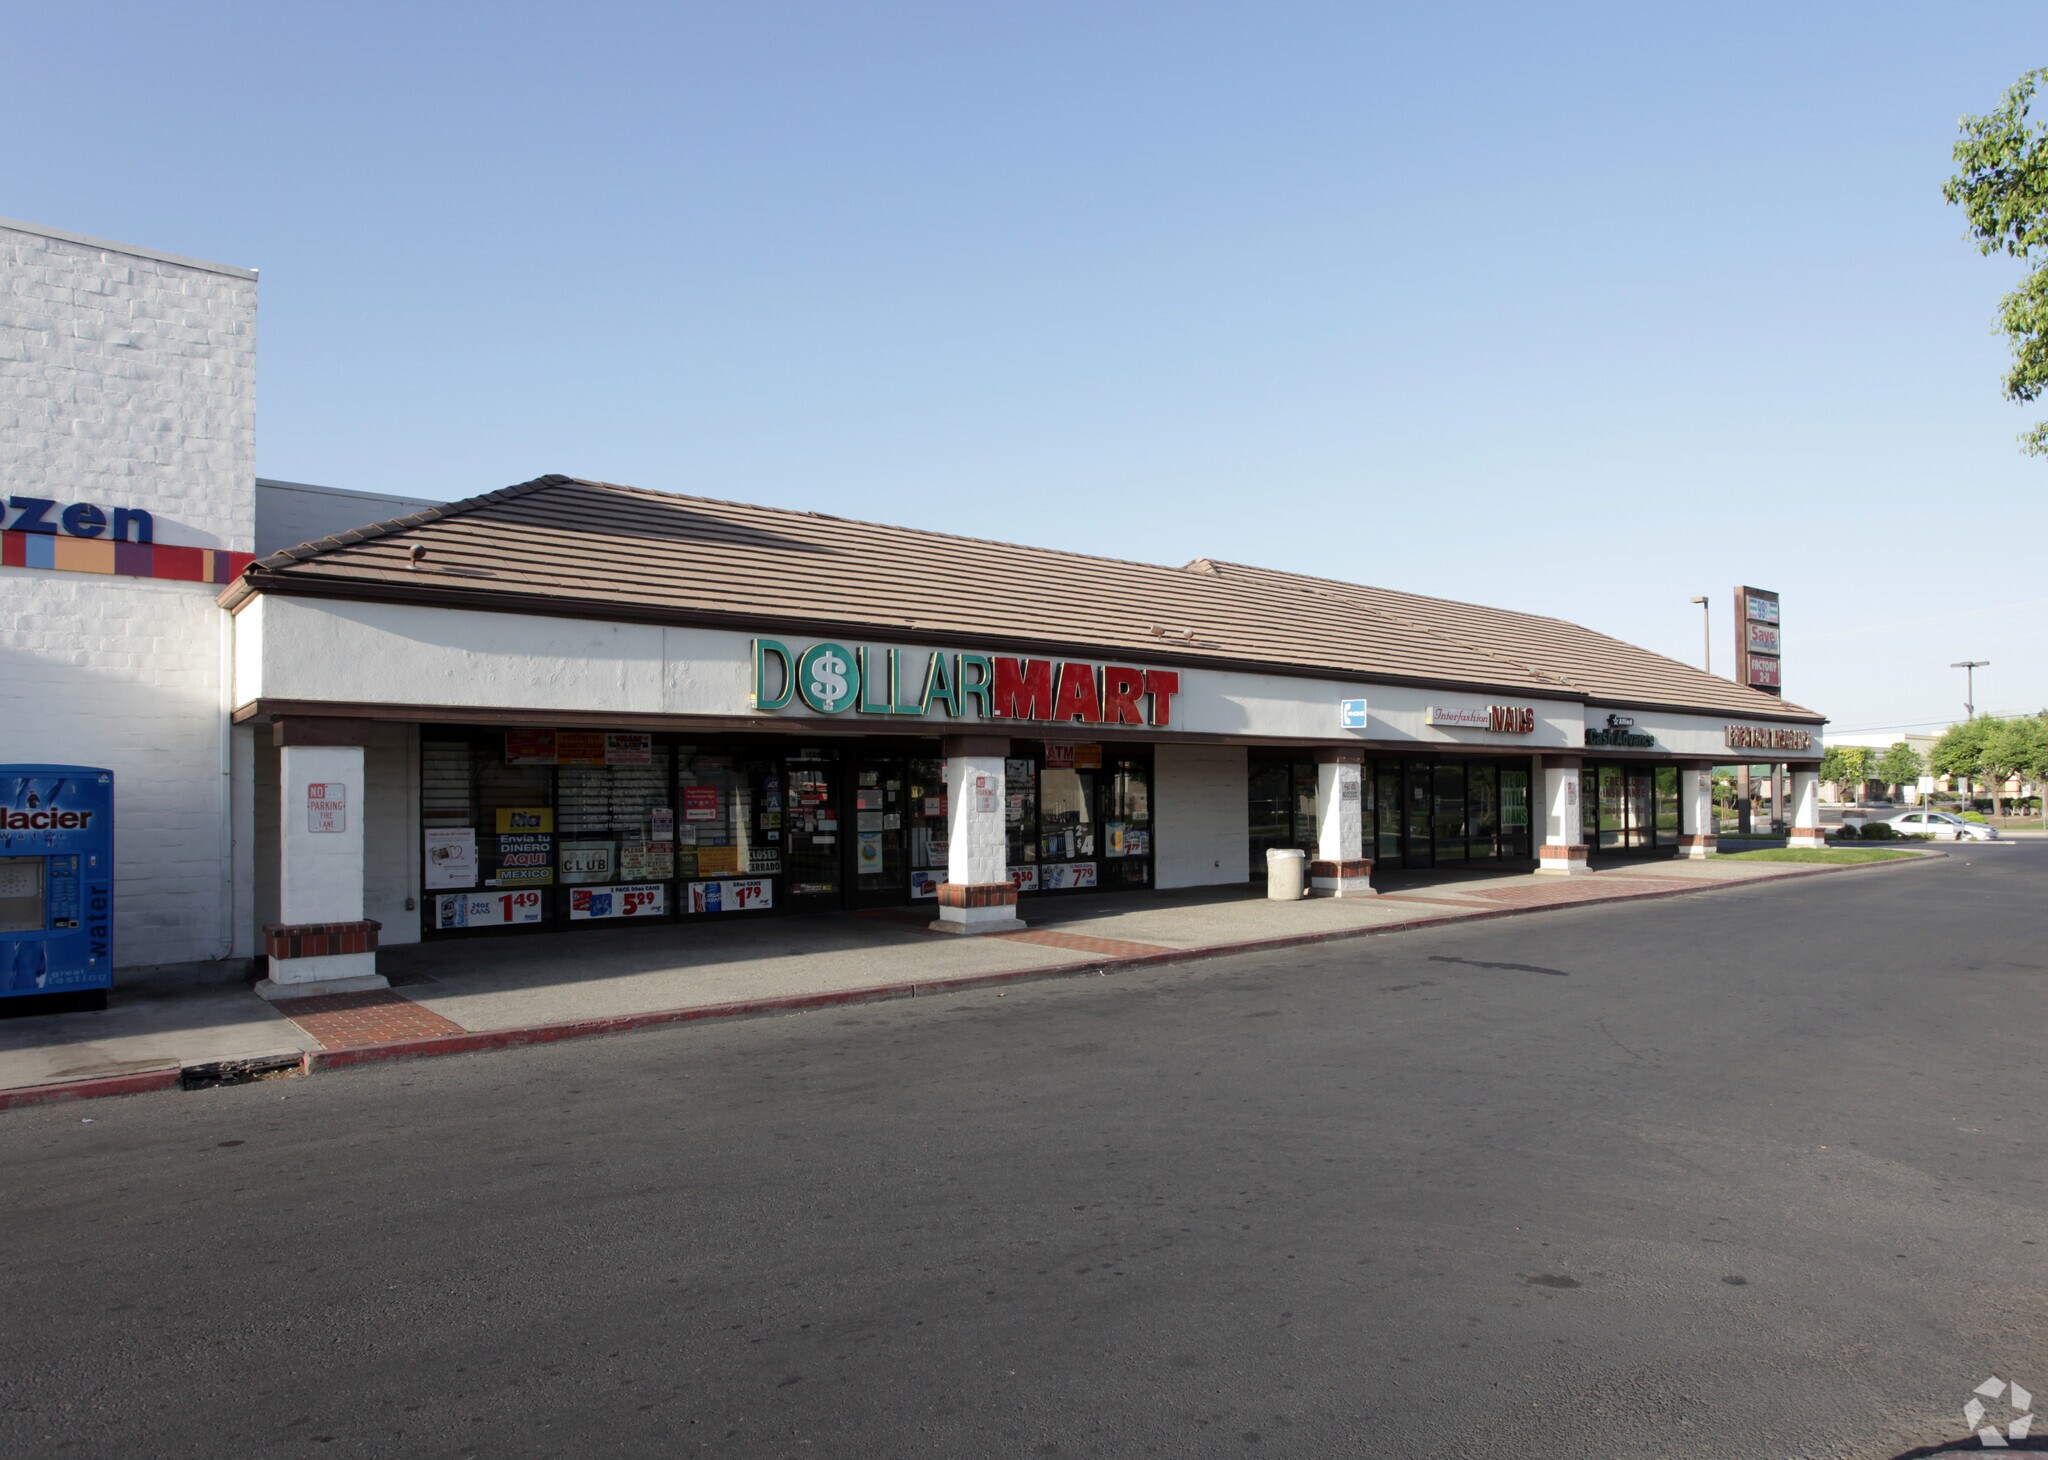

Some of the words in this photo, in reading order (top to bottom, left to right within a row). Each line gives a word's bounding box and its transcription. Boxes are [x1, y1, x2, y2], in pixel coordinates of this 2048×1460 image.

[0, 496, 153, 544] zen
[1752, 625, 1776, 643] Save
[1752, 660, 1777, 672] FACTORY
[1760, 672, 1770, 684] 2-U
[1434, 708, 1488, 724] Interfashion
[1488, 706, 1534, 733] NAILS
[1619, 718, 1633, 726] Allied
[1586, 729, 1614, 745] Cash
[1615, 730, 1654, 747] Advance
[1047, 745, 1074, 760] ATM
[310, 786, 324, 798] NO
[1503, 790, 1525, 806] TITLE
[1603, 788, 1646, 798] INSUNCE
[310, 802, 343, 811] PARKING
[1502, 808, 1527, 825] LOANS
[538, 834, 550, 842] tu
[501, 843, 550, 853] DINERO
[564, 860, 606, 871] CLUB
[501, 869, 550, 879] MEXICO
[86, 883, 108, 958] water
[48, 974, 107, 985] tasting
[52, 969, 84, 978] great
